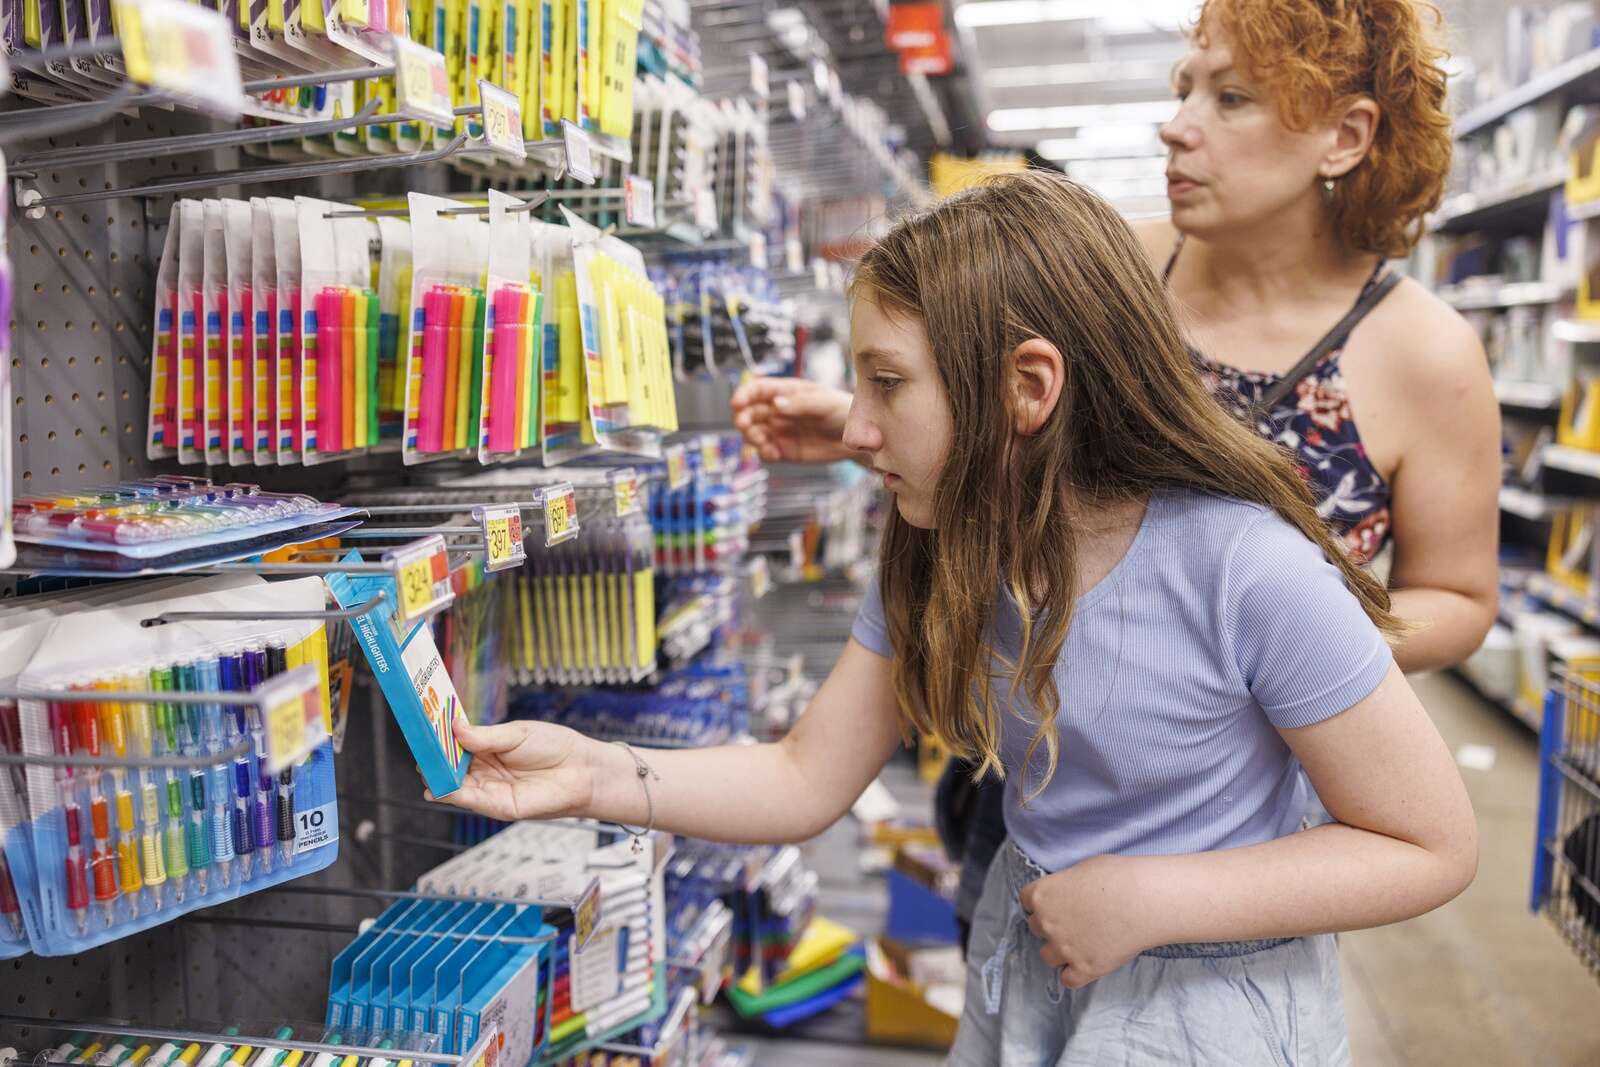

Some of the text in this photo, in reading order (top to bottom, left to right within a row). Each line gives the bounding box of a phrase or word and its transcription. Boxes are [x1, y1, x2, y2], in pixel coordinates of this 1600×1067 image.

[551, 506, 565, 535] 697
[489, 528, 507, 559] 397
[355, 614, 365, 625] EL
[359, 623, 391, 674] HIGHLIGHTERS
[300, 810, 324, 830] 10
[299, 834, 328, 848] PENCILS
